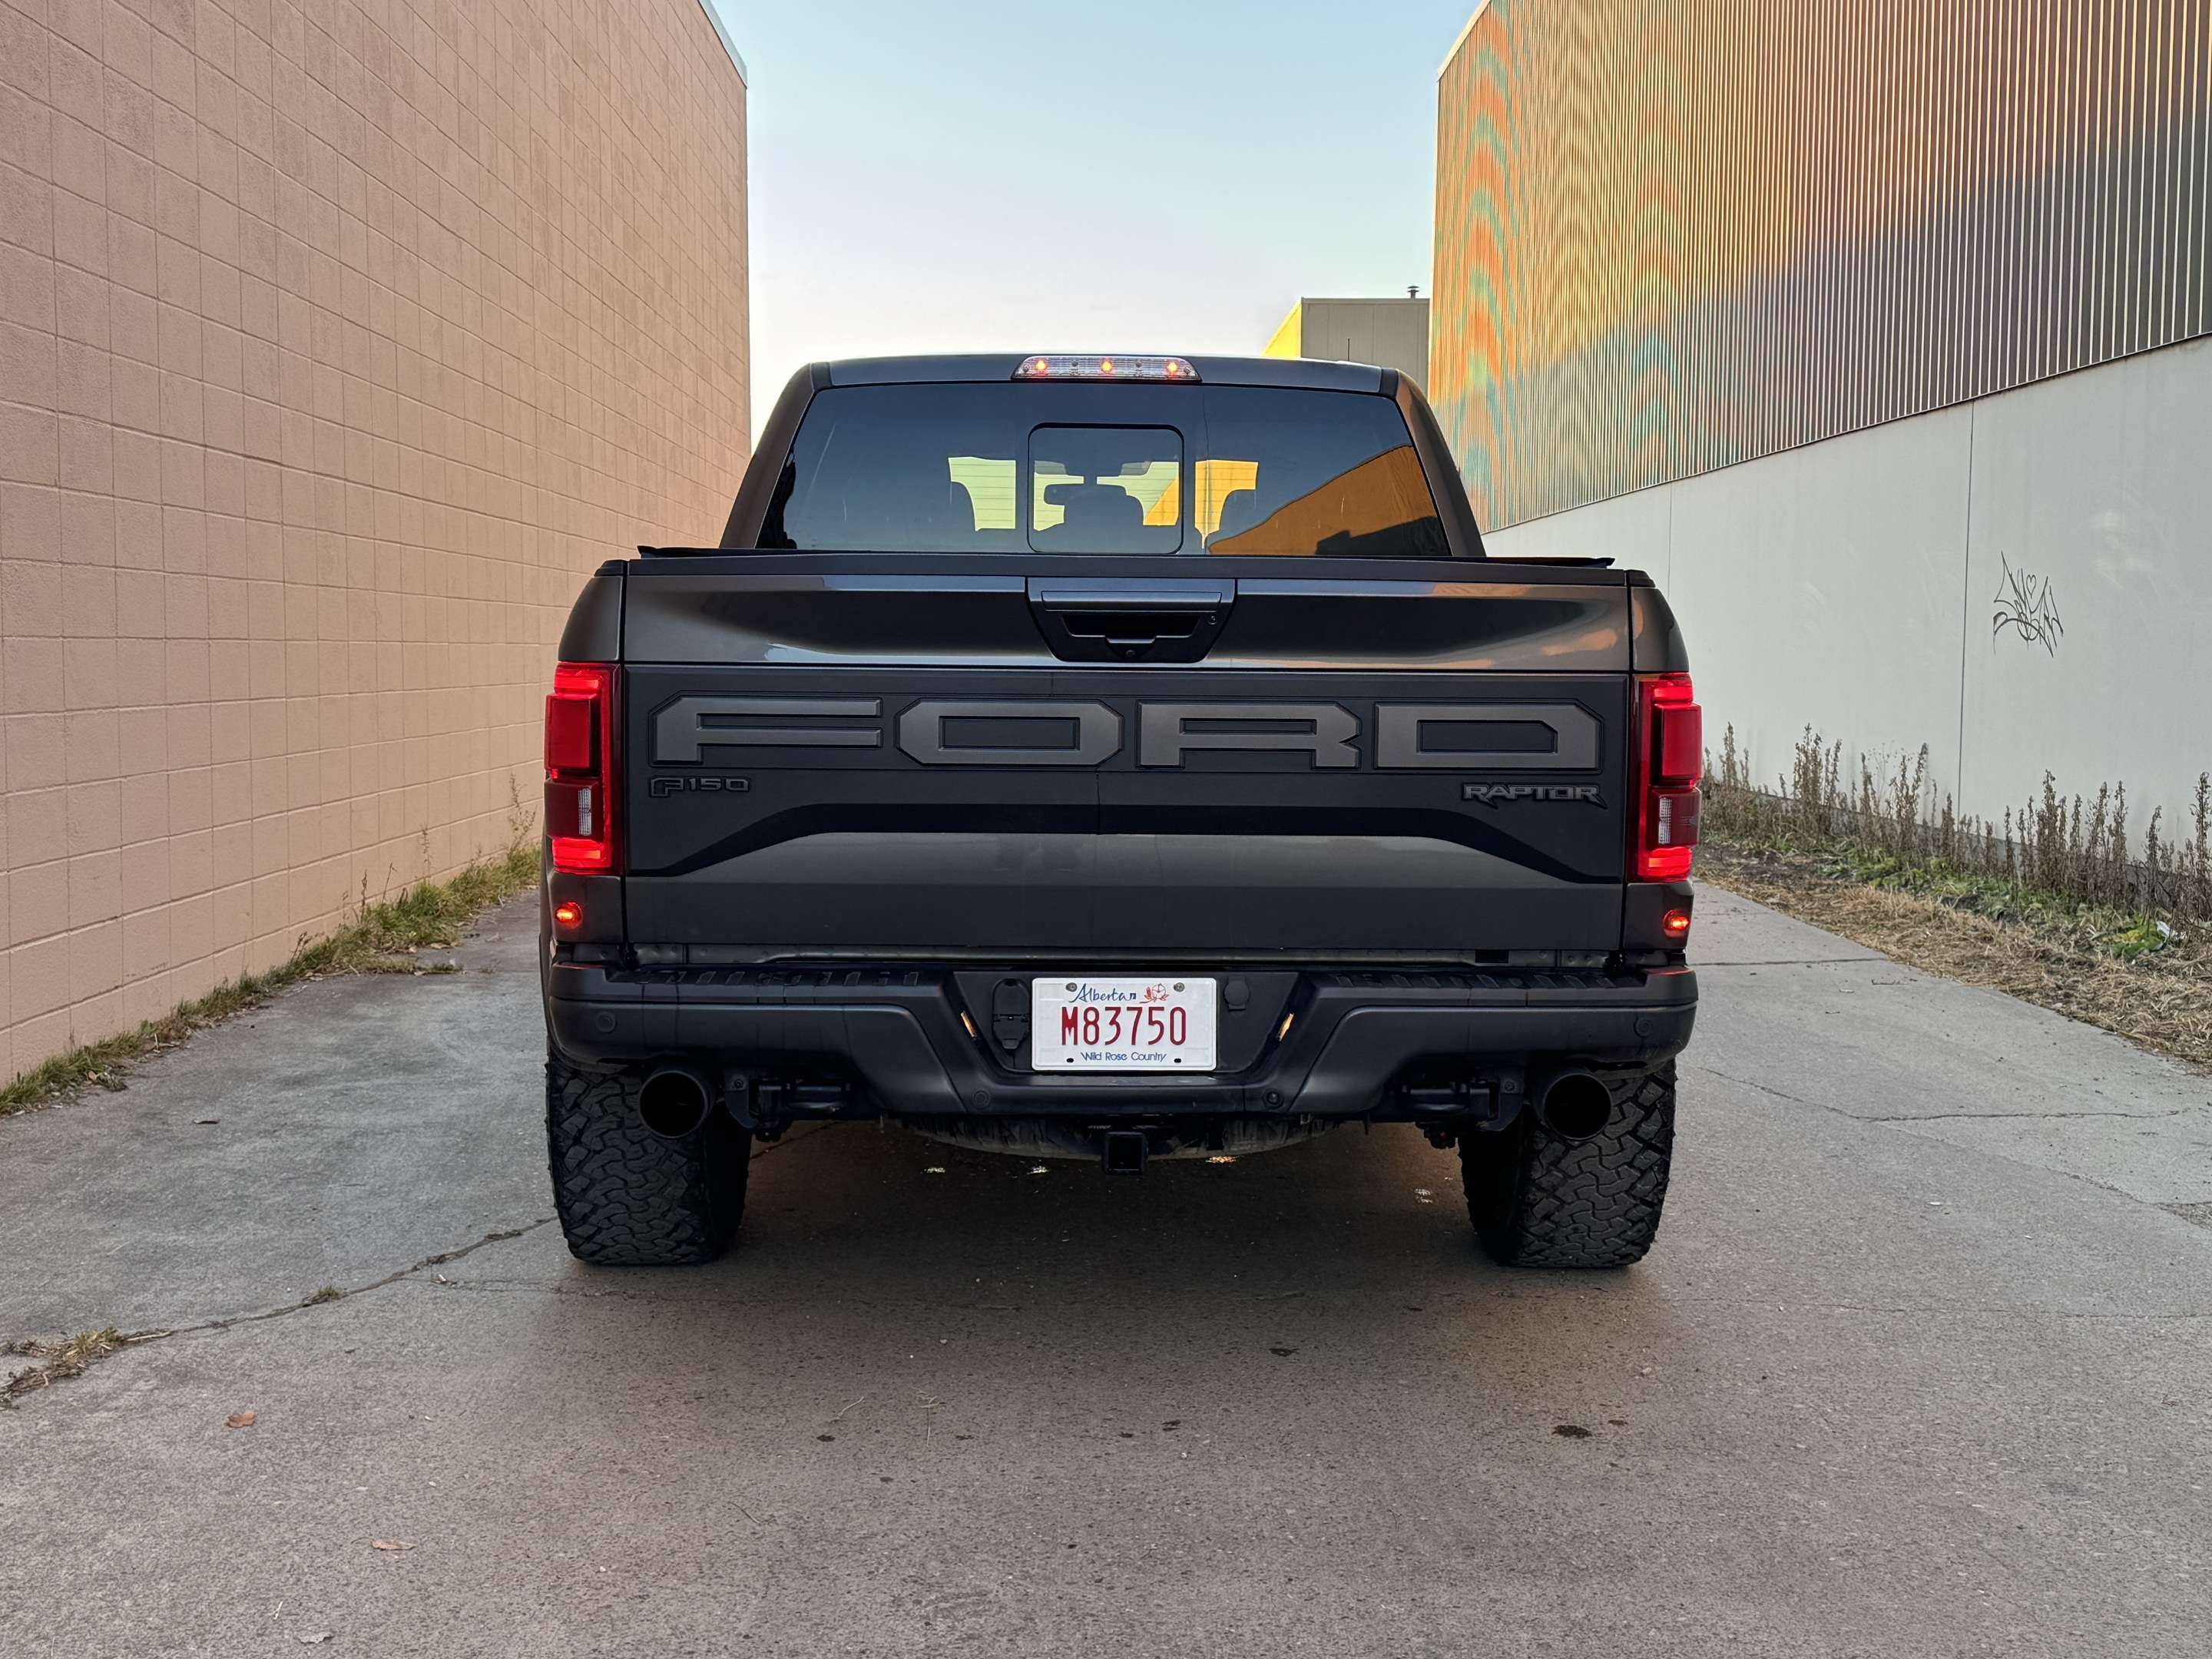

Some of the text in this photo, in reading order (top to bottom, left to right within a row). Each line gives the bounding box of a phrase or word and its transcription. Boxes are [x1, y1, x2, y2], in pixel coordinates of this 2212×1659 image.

[651, 694, 1601, 770] FORD
[1462, 783, 1608, 809] RAPTOR
[1068, 983, 1131, 1003] Alberta
[1061, 1006, 1187, 1045] M83750
[1081, 1051, 1167, 1062] Wild Rose Country
